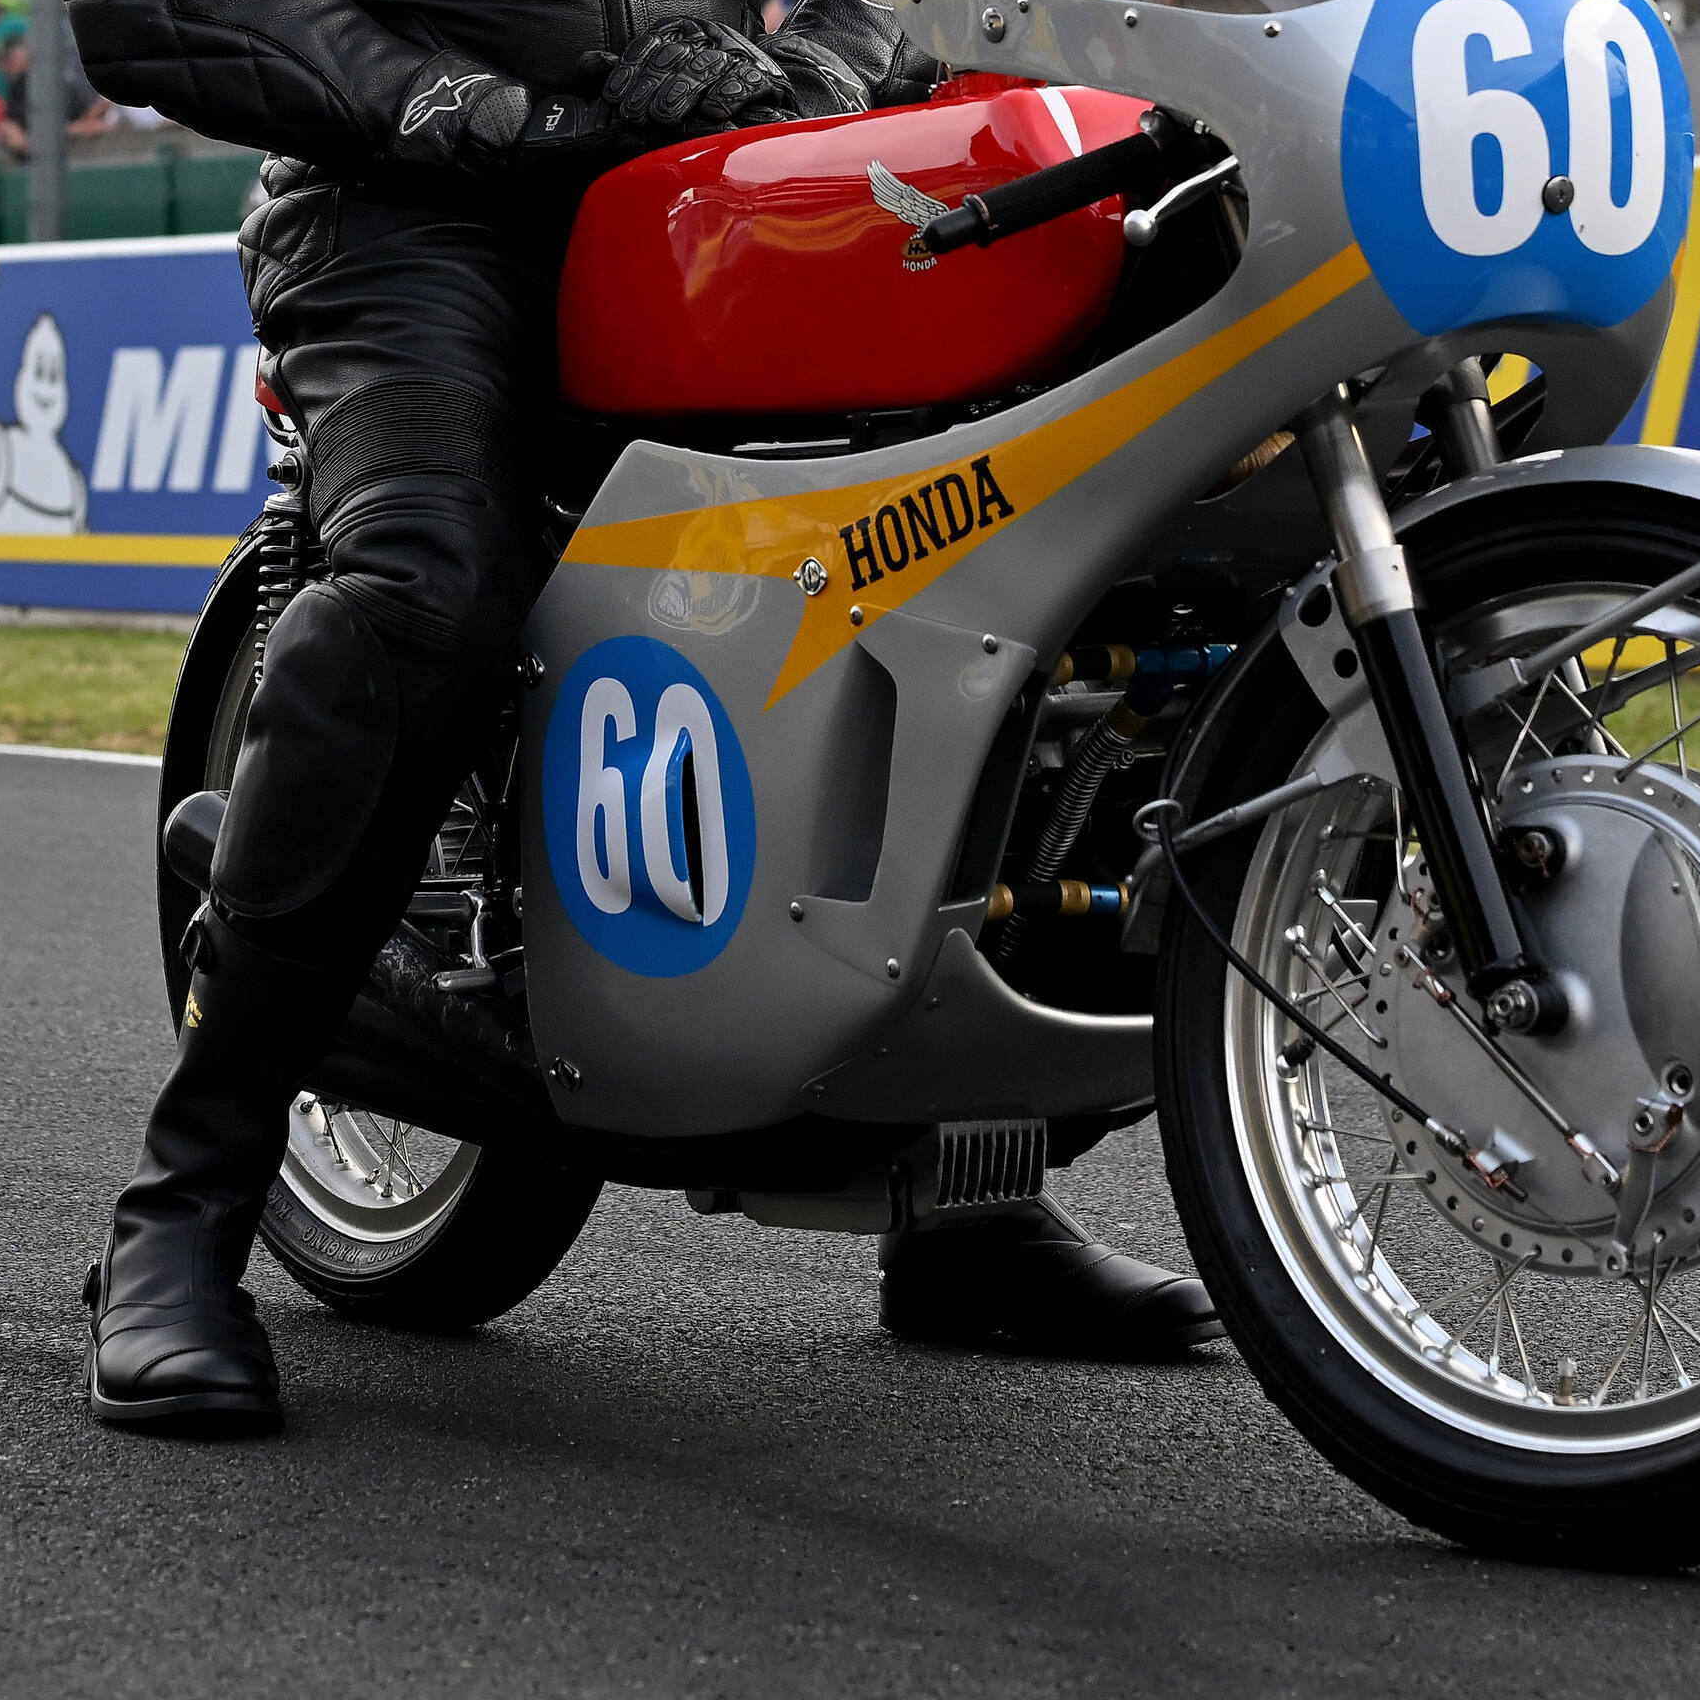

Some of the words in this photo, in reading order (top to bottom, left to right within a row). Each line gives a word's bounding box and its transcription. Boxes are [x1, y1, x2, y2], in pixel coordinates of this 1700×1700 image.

[902, 257, 937, 272] HONDA
[839, 455, 1015, 592] HONDA
[576, 676, 729, 927] 60
[303, 1226, 362, 1263] RACING
